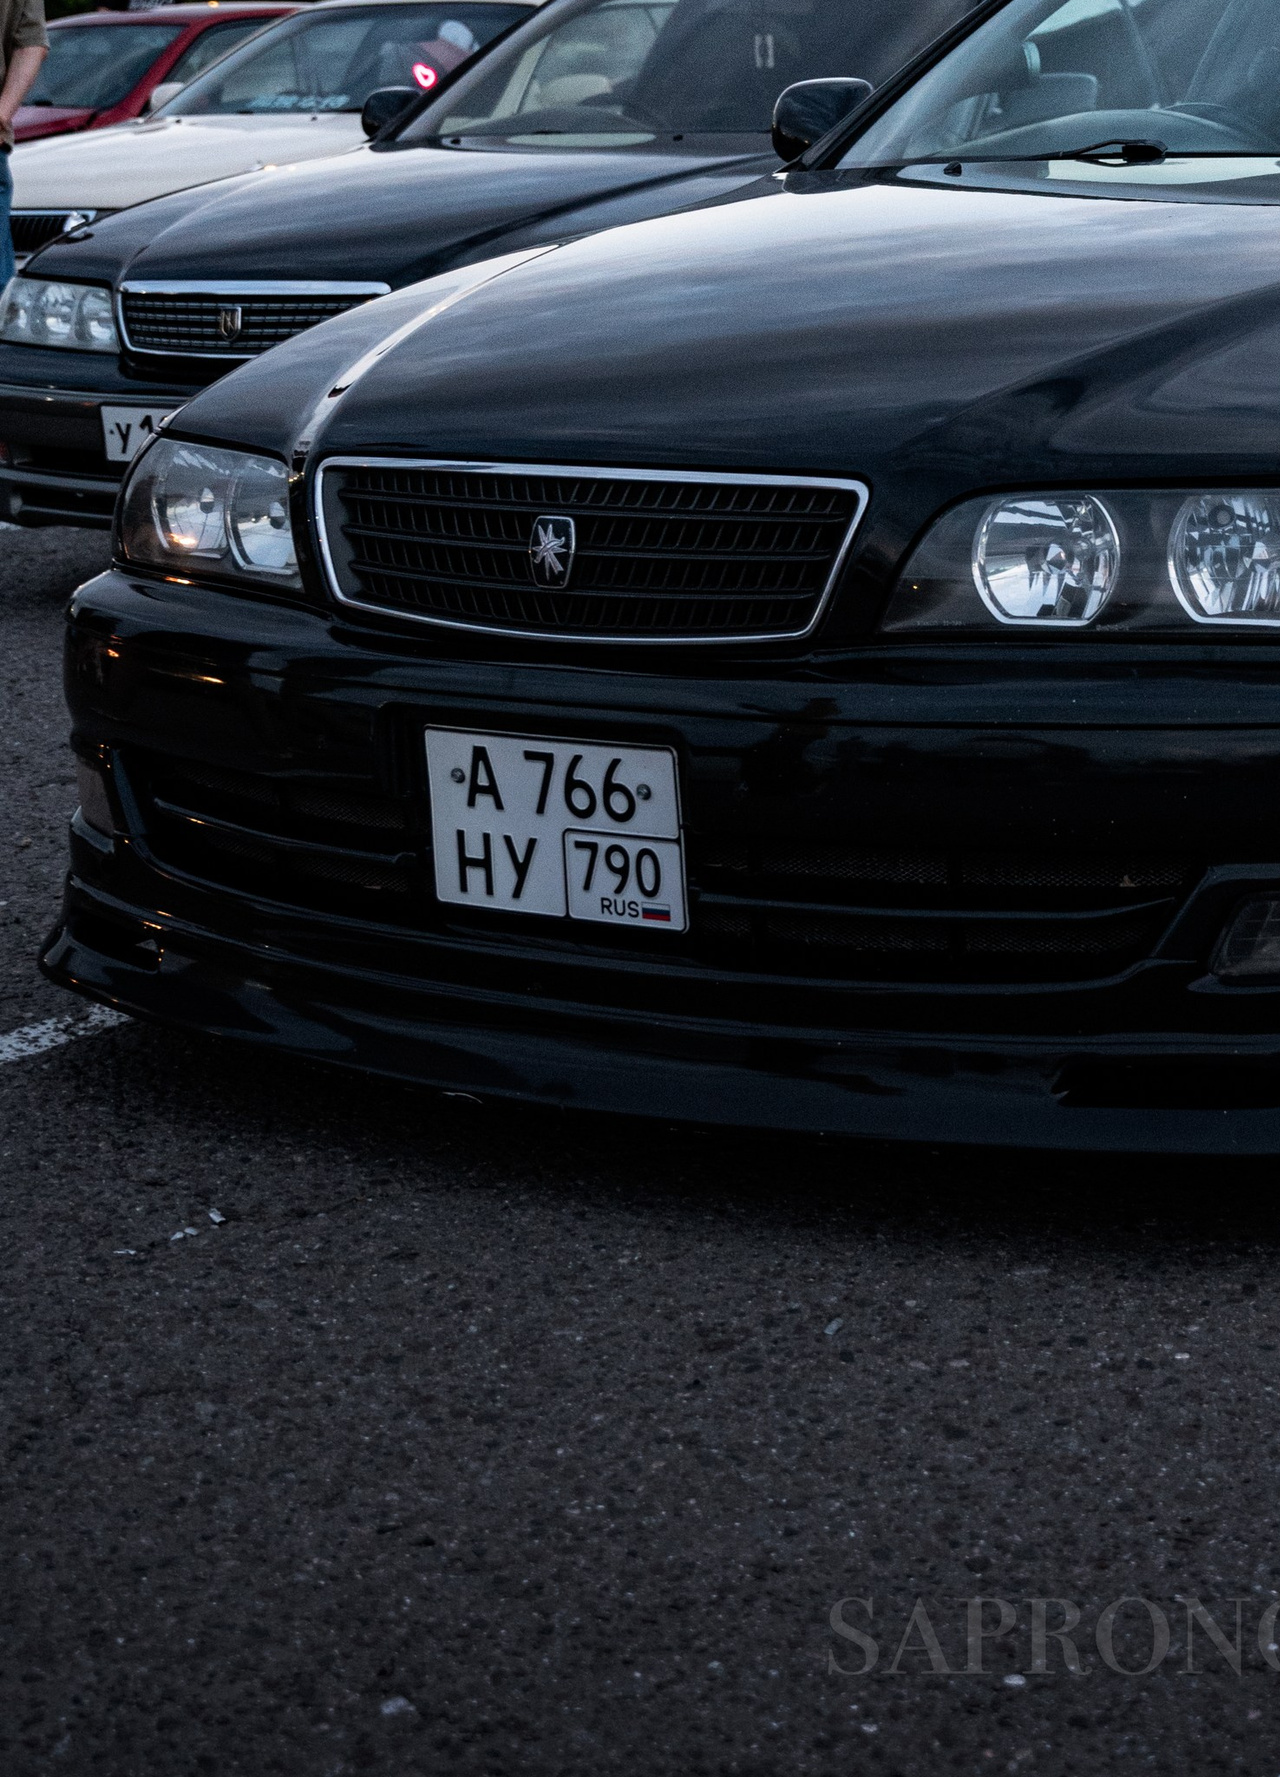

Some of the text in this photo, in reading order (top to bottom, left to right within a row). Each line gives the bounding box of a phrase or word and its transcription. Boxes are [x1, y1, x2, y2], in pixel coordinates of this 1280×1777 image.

[523, 749, 636, 822] 766
[574, 840, 661, 898] 790
[600, 897, 639, 918] RUS
